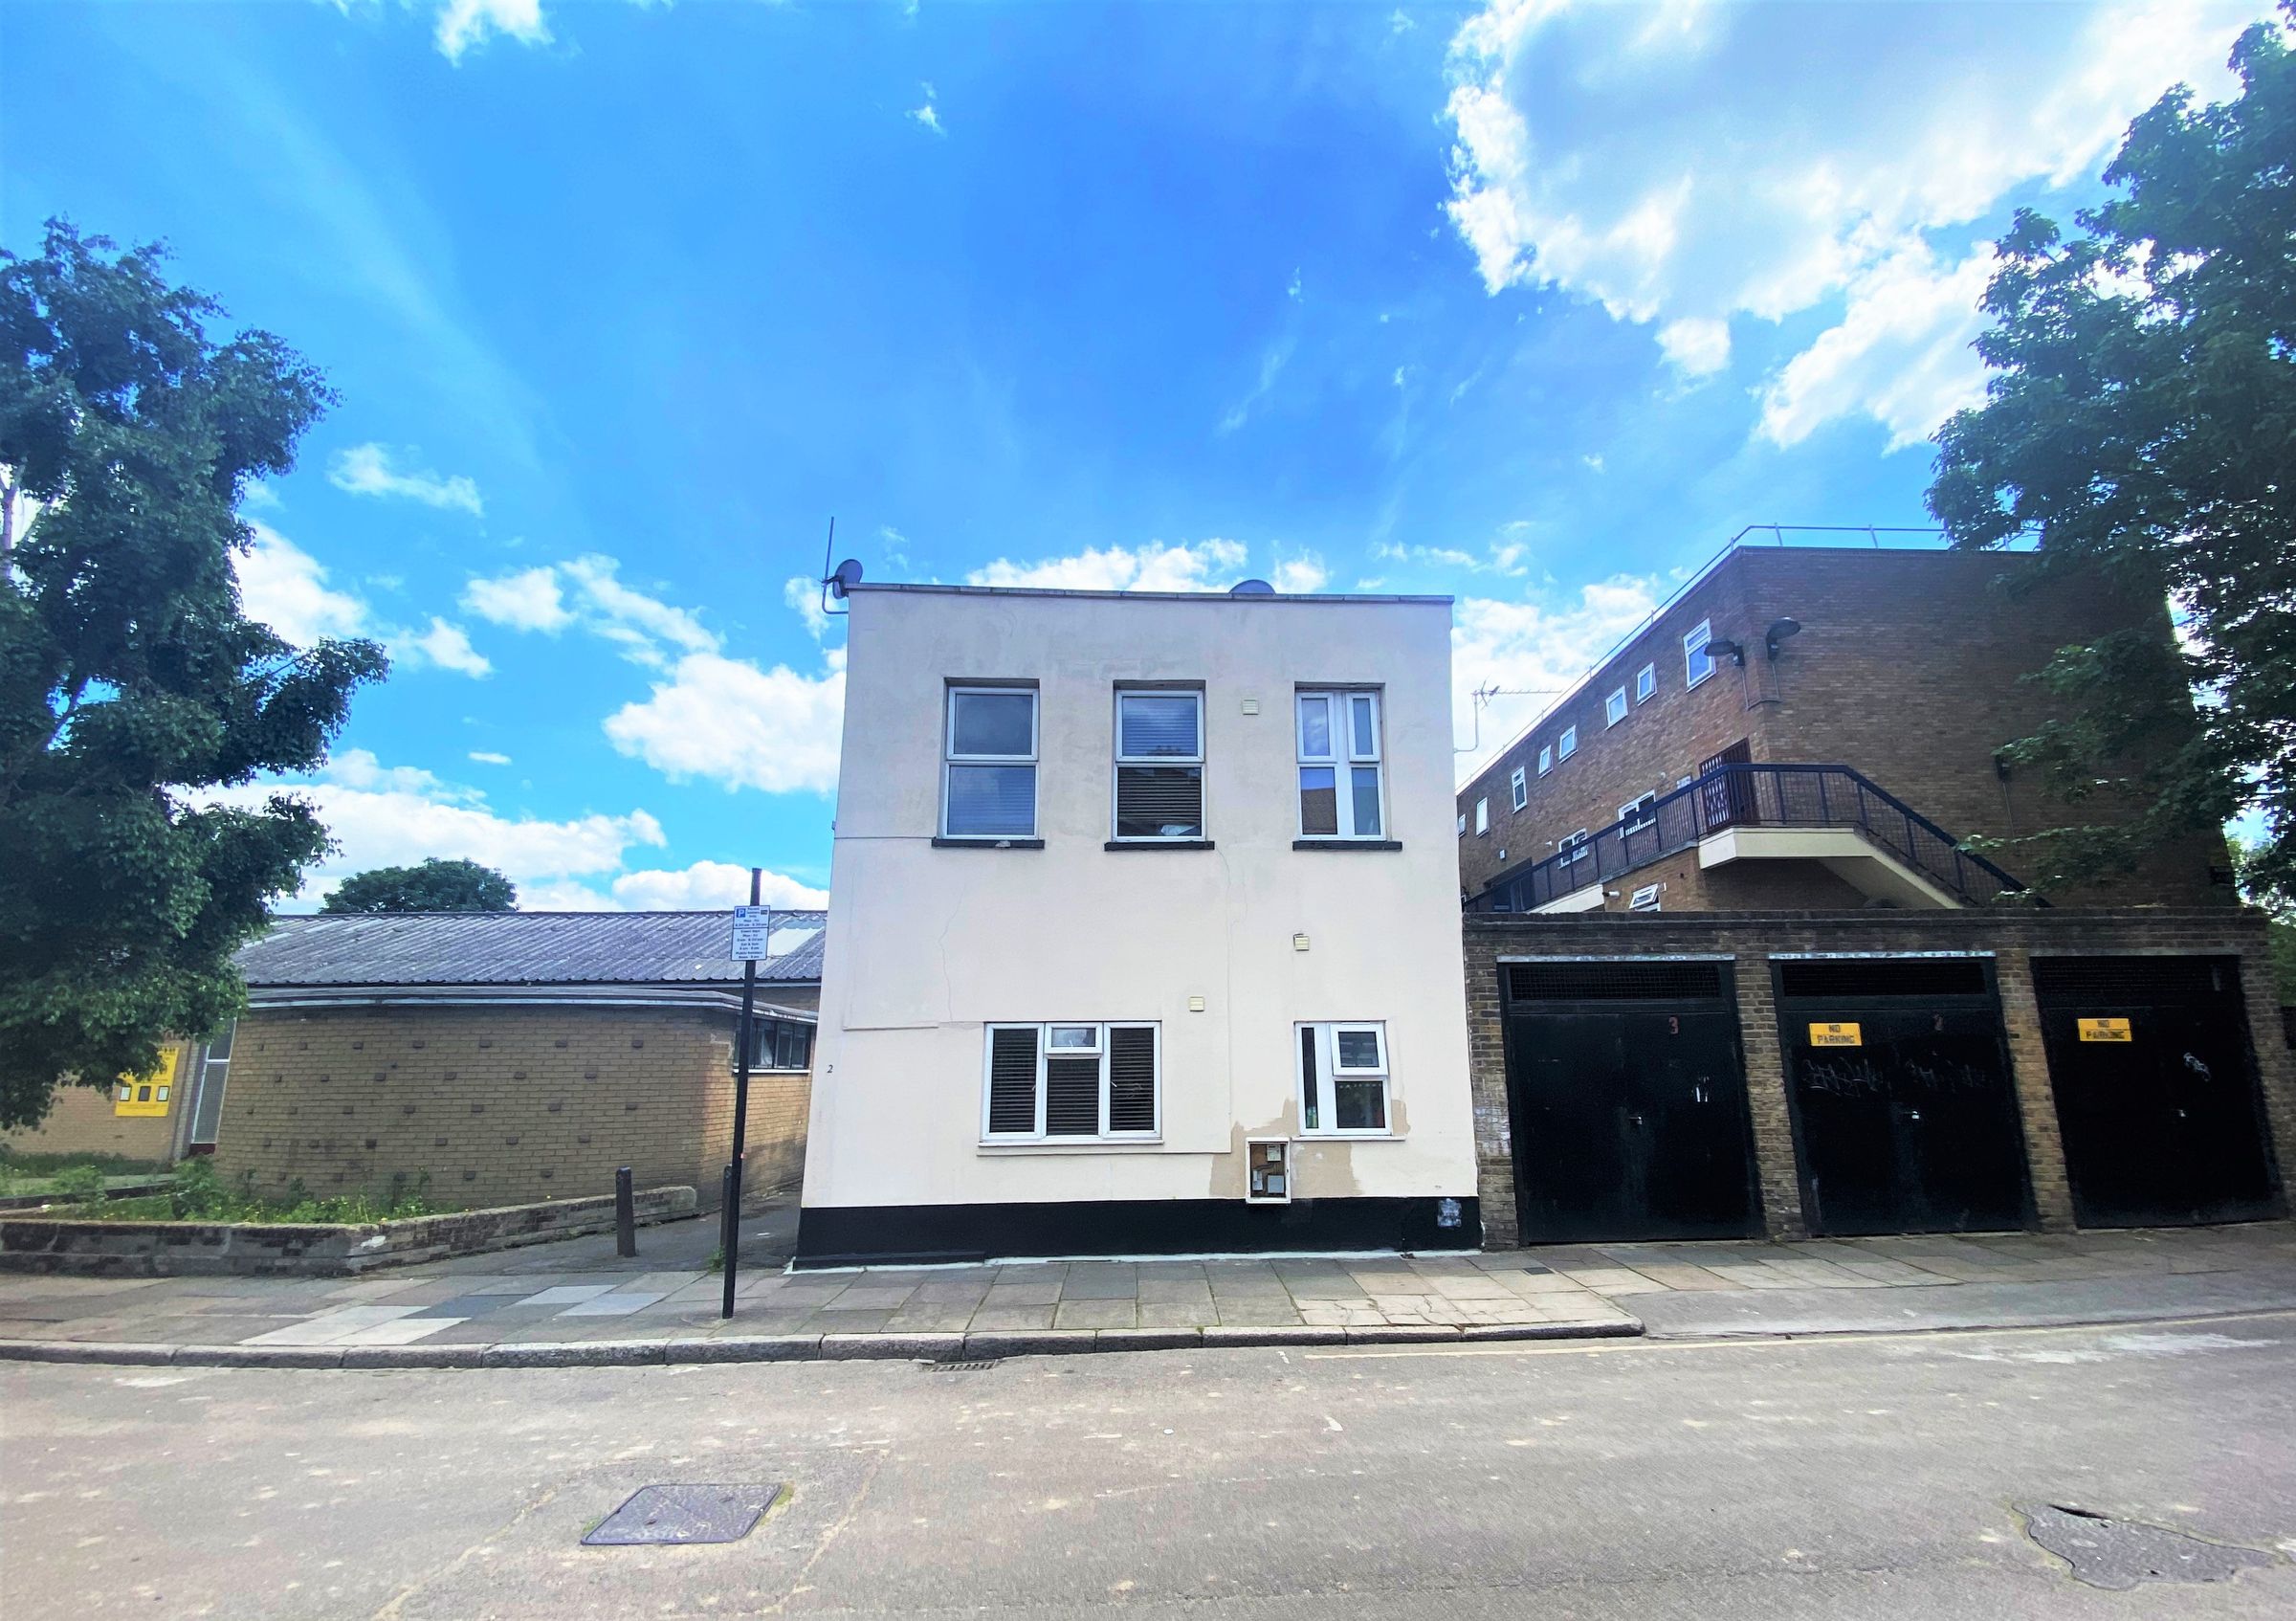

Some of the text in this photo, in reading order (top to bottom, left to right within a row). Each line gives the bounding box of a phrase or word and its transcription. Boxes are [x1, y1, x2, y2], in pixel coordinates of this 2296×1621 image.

[1668, 1016, 1679, 1034] 3
[1828, 1024, 1841, 1033] NO
[1817, 1034, 1855, 1044] PARKING
[827, 1064, 833, 1074] 2
